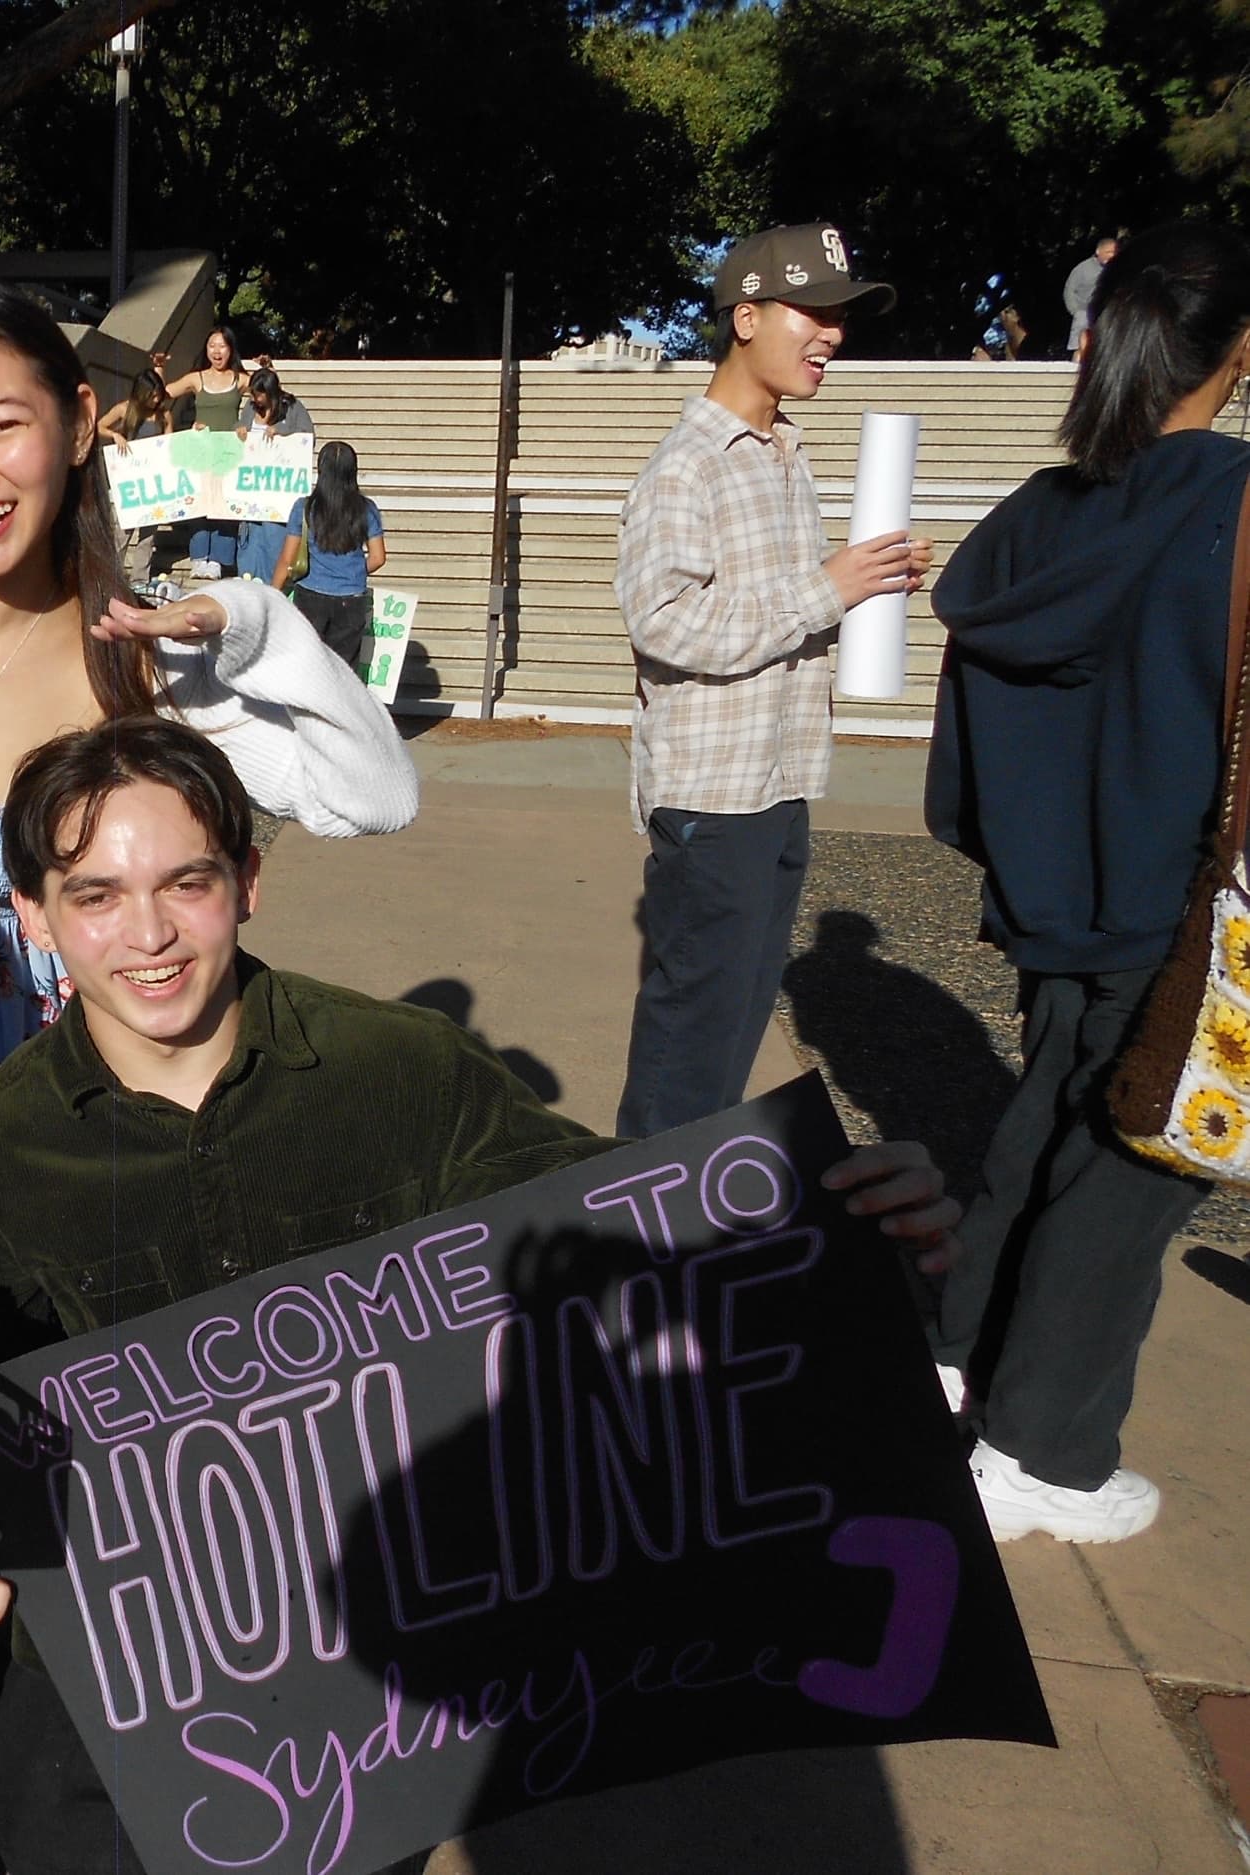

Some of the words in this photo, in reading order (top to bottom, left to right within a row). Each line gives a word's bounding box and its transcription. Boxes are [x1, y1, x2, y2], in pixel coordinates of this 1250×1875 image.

[117, 468, 195, 509] ELLA
[236, 465, 310, 494] EMMA
[383, 594, 407, 618] to
[585, 1135, 802, 1258] TO
[46, 1226, 833, 1731] HOTLINE
